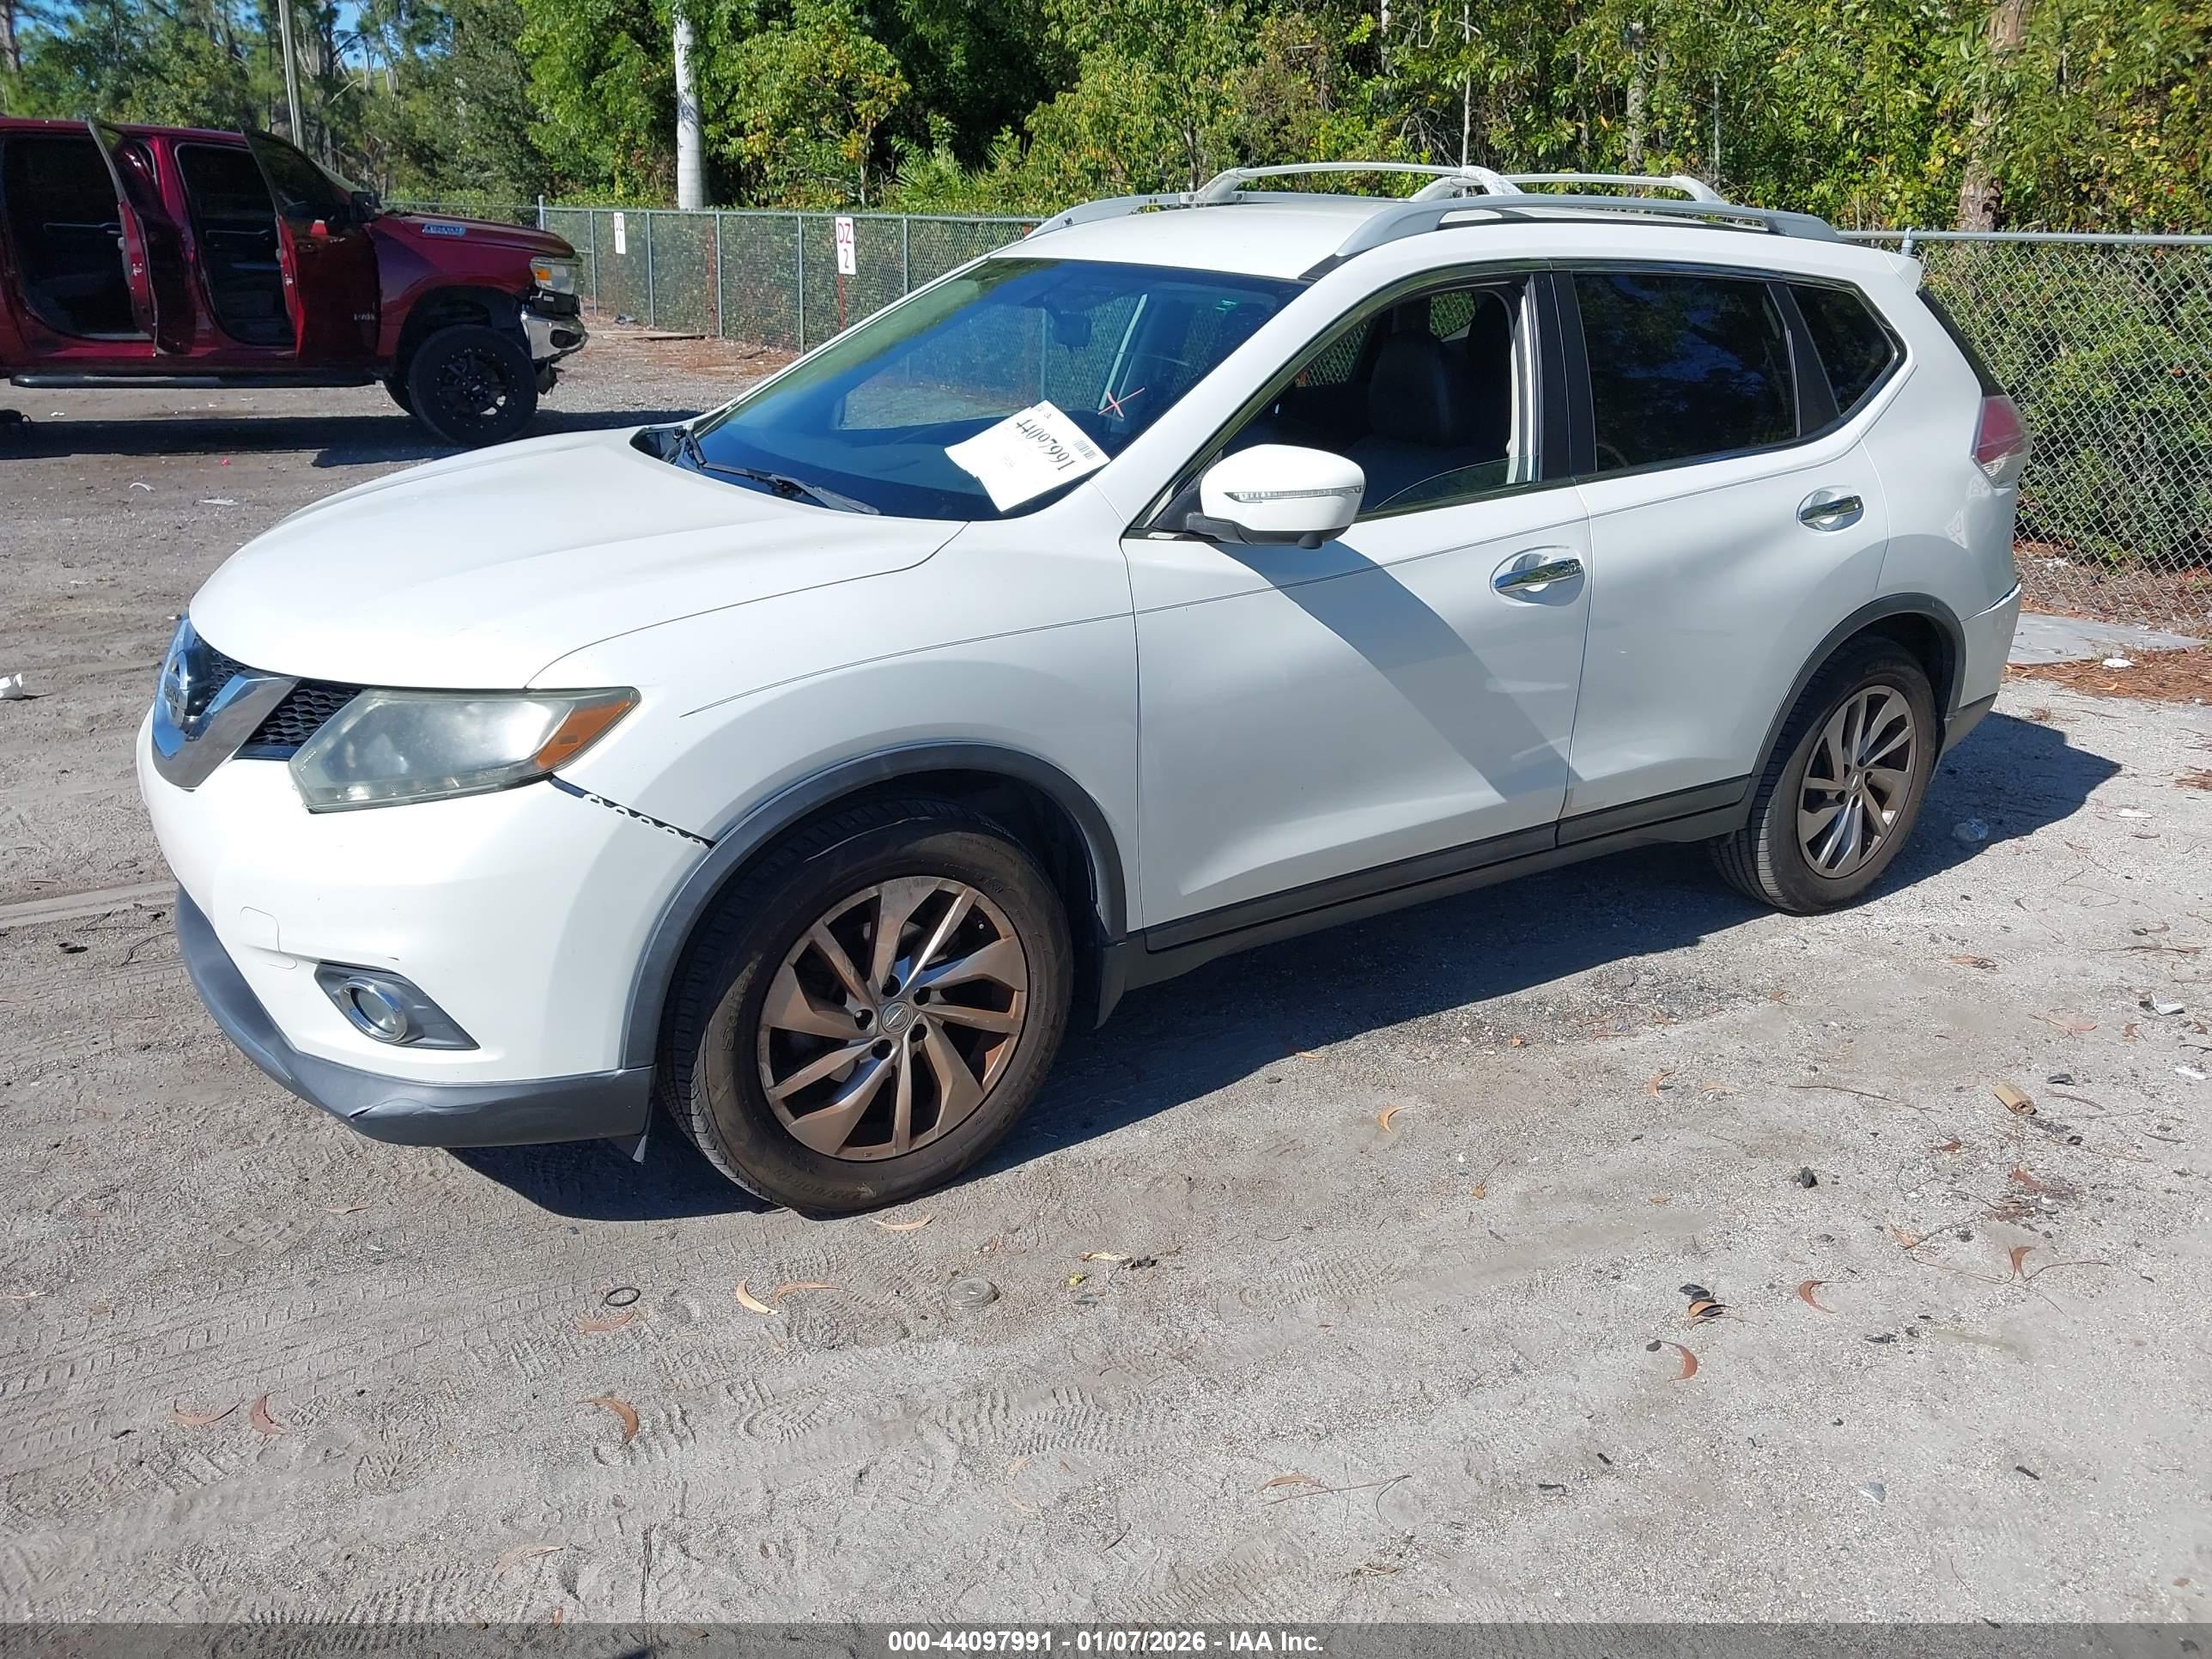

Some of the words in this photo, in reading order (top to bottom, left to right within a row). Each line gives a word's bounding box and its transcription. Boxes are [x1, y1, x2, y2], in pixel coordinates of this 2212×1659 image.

[837, 222, 852, 245] DZ
[843, 247, 849, 269] 2
[1015, 418, 1076, 471] 44097991
